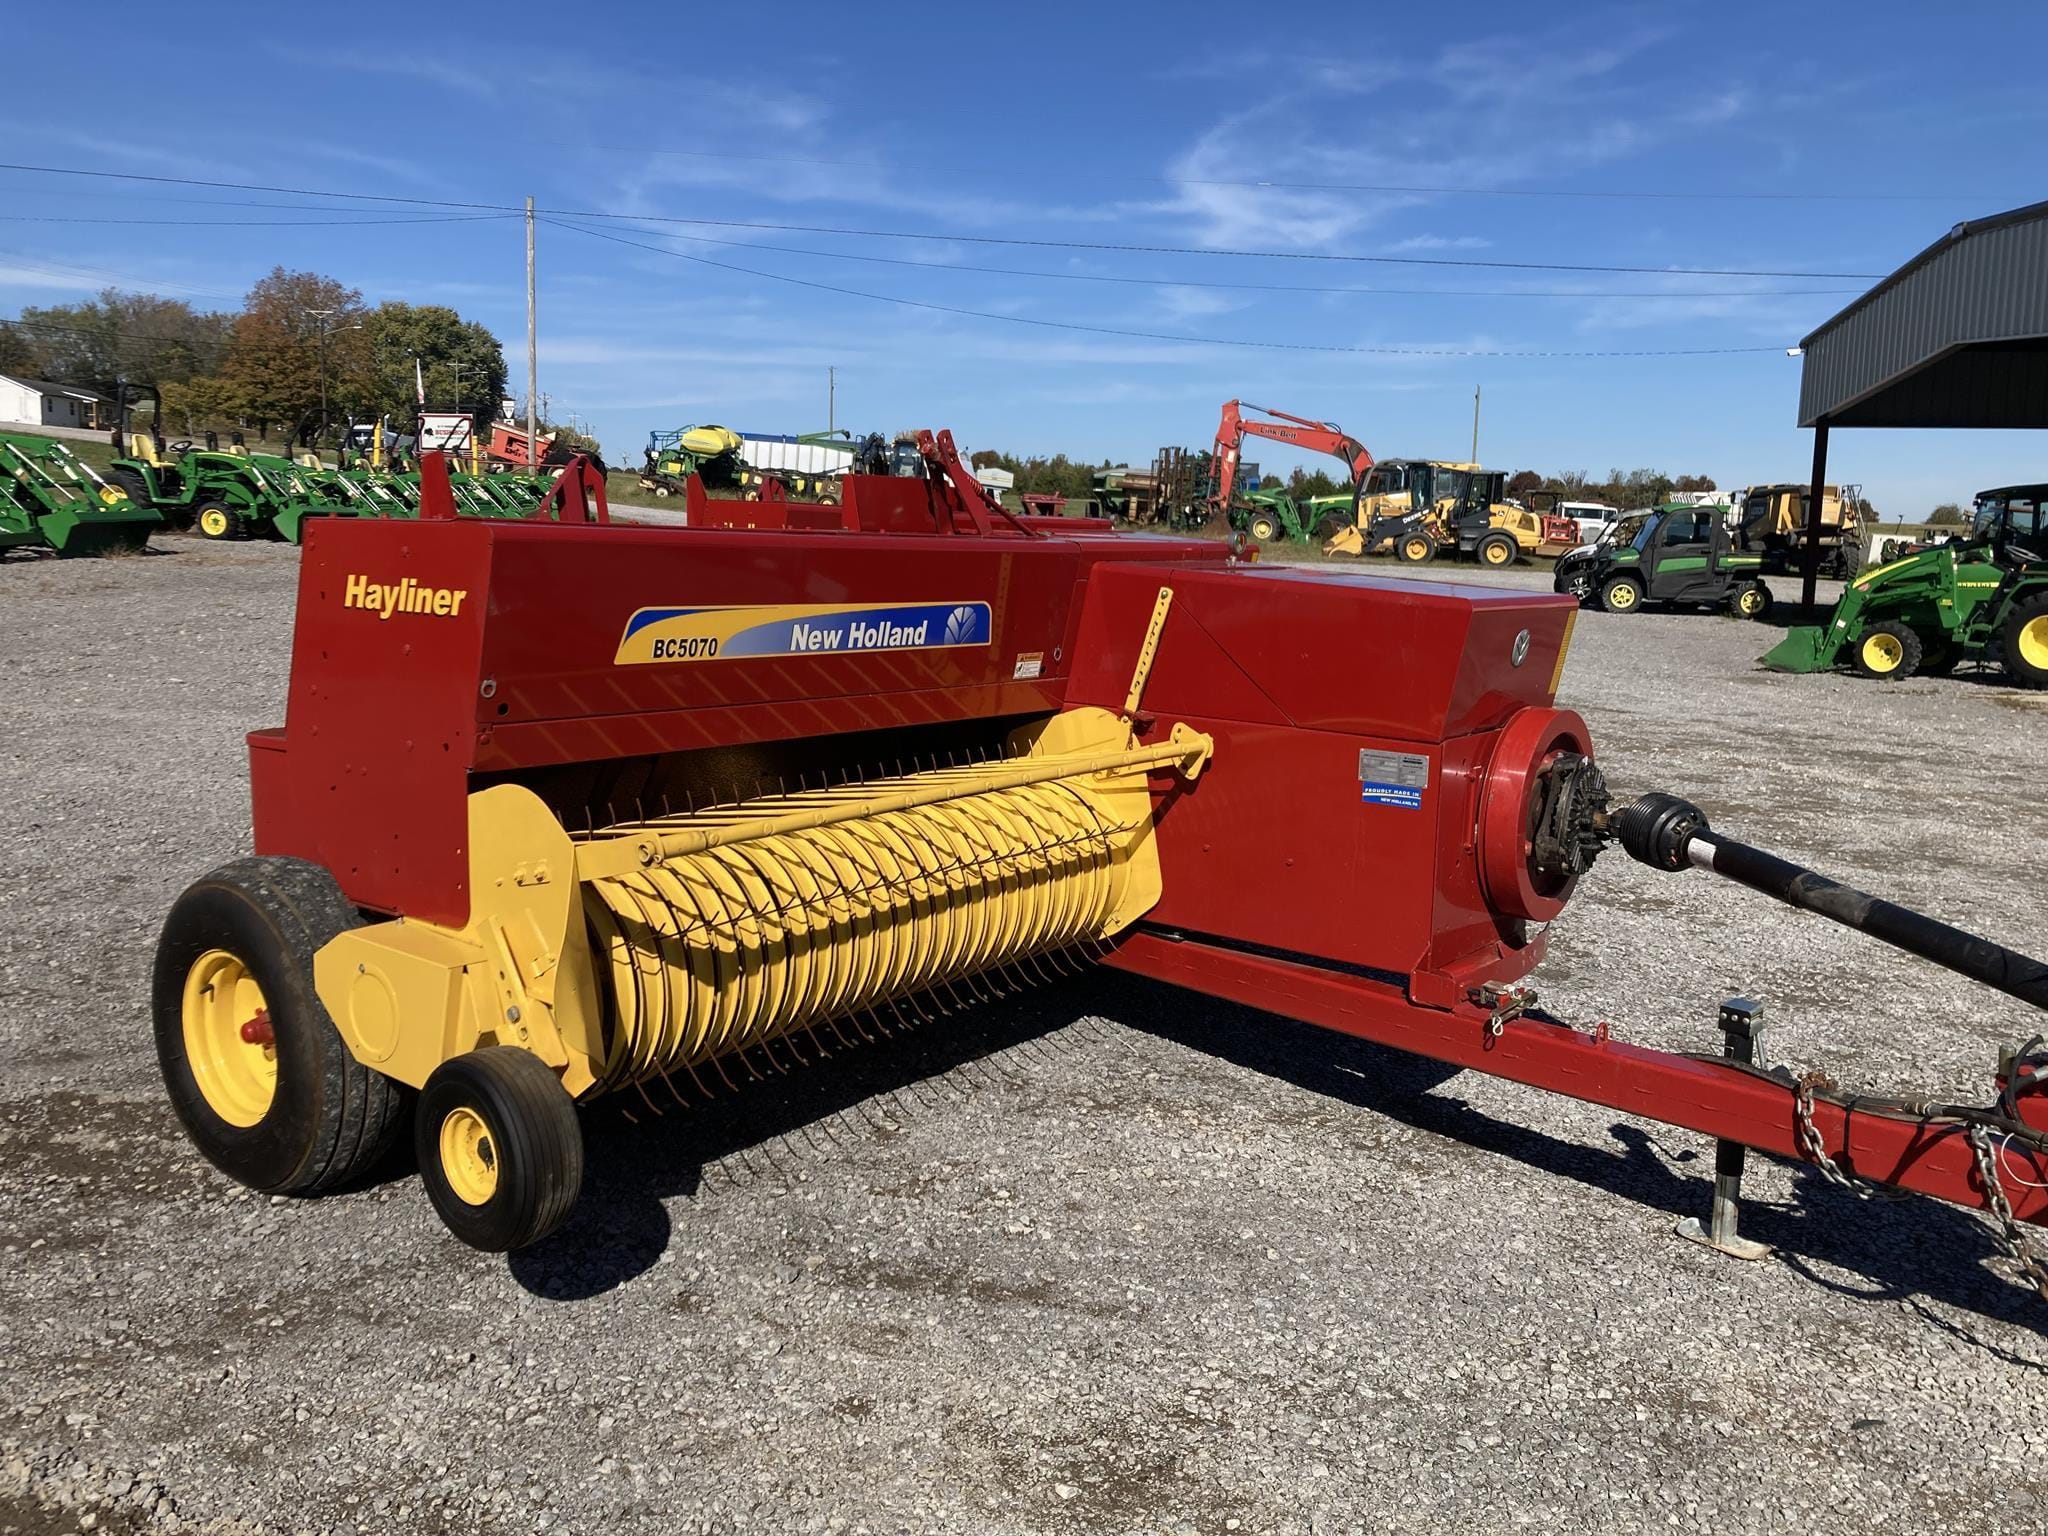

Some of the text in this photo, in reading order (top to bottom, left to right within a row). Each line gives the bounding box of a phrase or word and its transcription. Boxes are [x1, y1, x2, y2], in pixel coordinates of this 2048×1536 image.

[1402, 511, 1422, 524] DEERE
[344, 574, 467, 620] Hayliner
[652, 637, 718, 659] BC5070
[790, 620, 928, 651] New Holland
